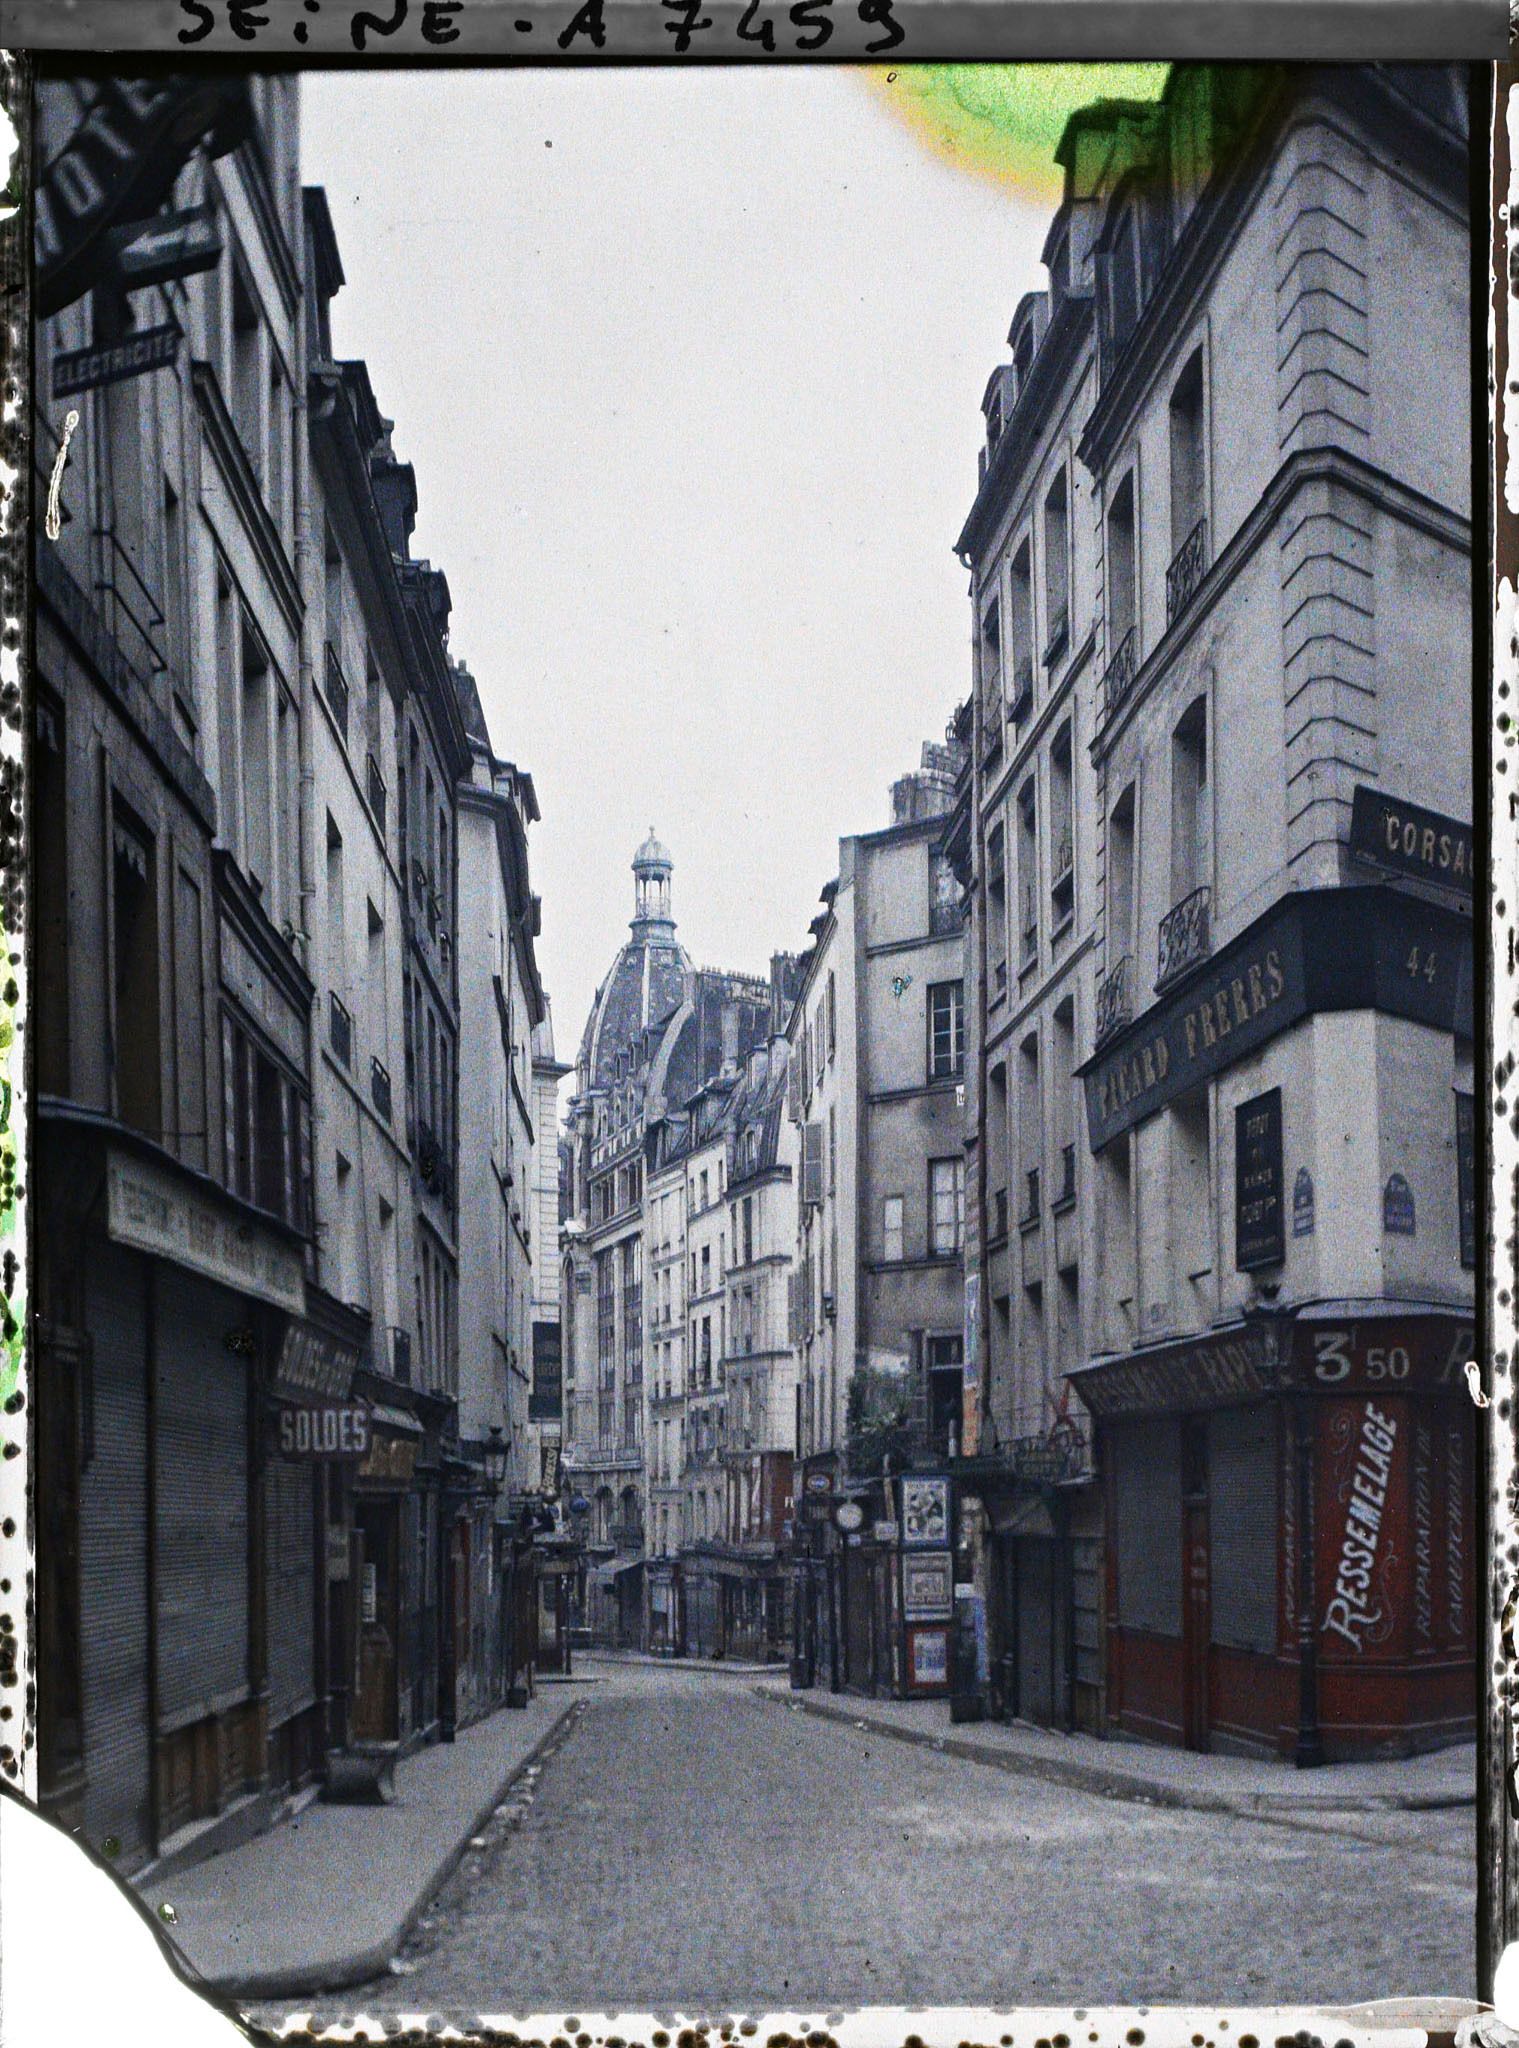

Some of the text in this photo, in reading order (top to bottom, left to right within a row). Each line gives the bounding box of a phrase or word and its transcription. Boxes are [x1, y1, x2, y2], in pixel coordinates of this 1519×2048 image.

[1408, 946, 1438, 983] 44
[1100, 1037, 1170, 1120] PICARD
[1366, 1347, 1410, 1380] 50
[279, 1409, 368, 1452] SOLDES
[1320, 1401, 1397, 1653] RESSEMELAGE
